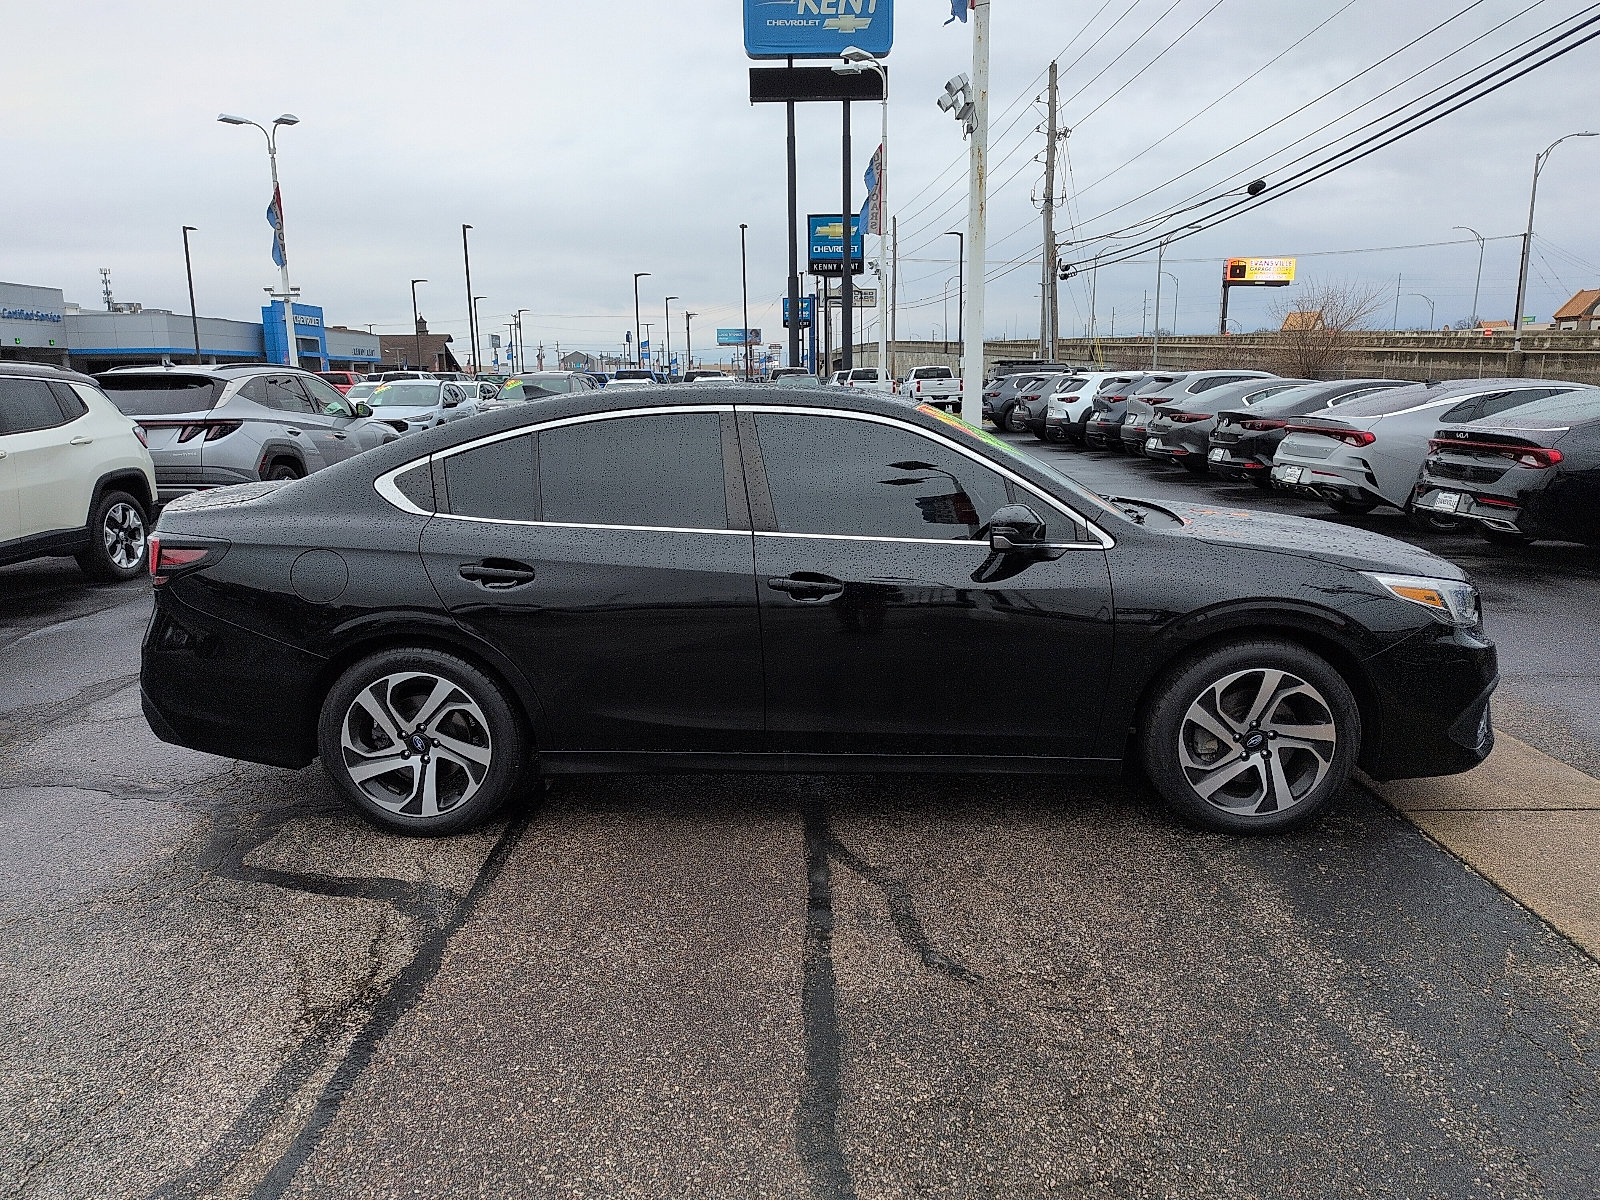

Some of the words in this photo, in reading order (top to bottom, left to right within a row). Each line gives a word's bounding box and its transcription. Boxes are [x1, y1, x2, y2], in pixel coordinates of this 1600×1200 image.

[813, 245, 859, 253] CHEVROET
[813, 263, 838, 271] KENNY
[840, 263, 859, 271] KNT
